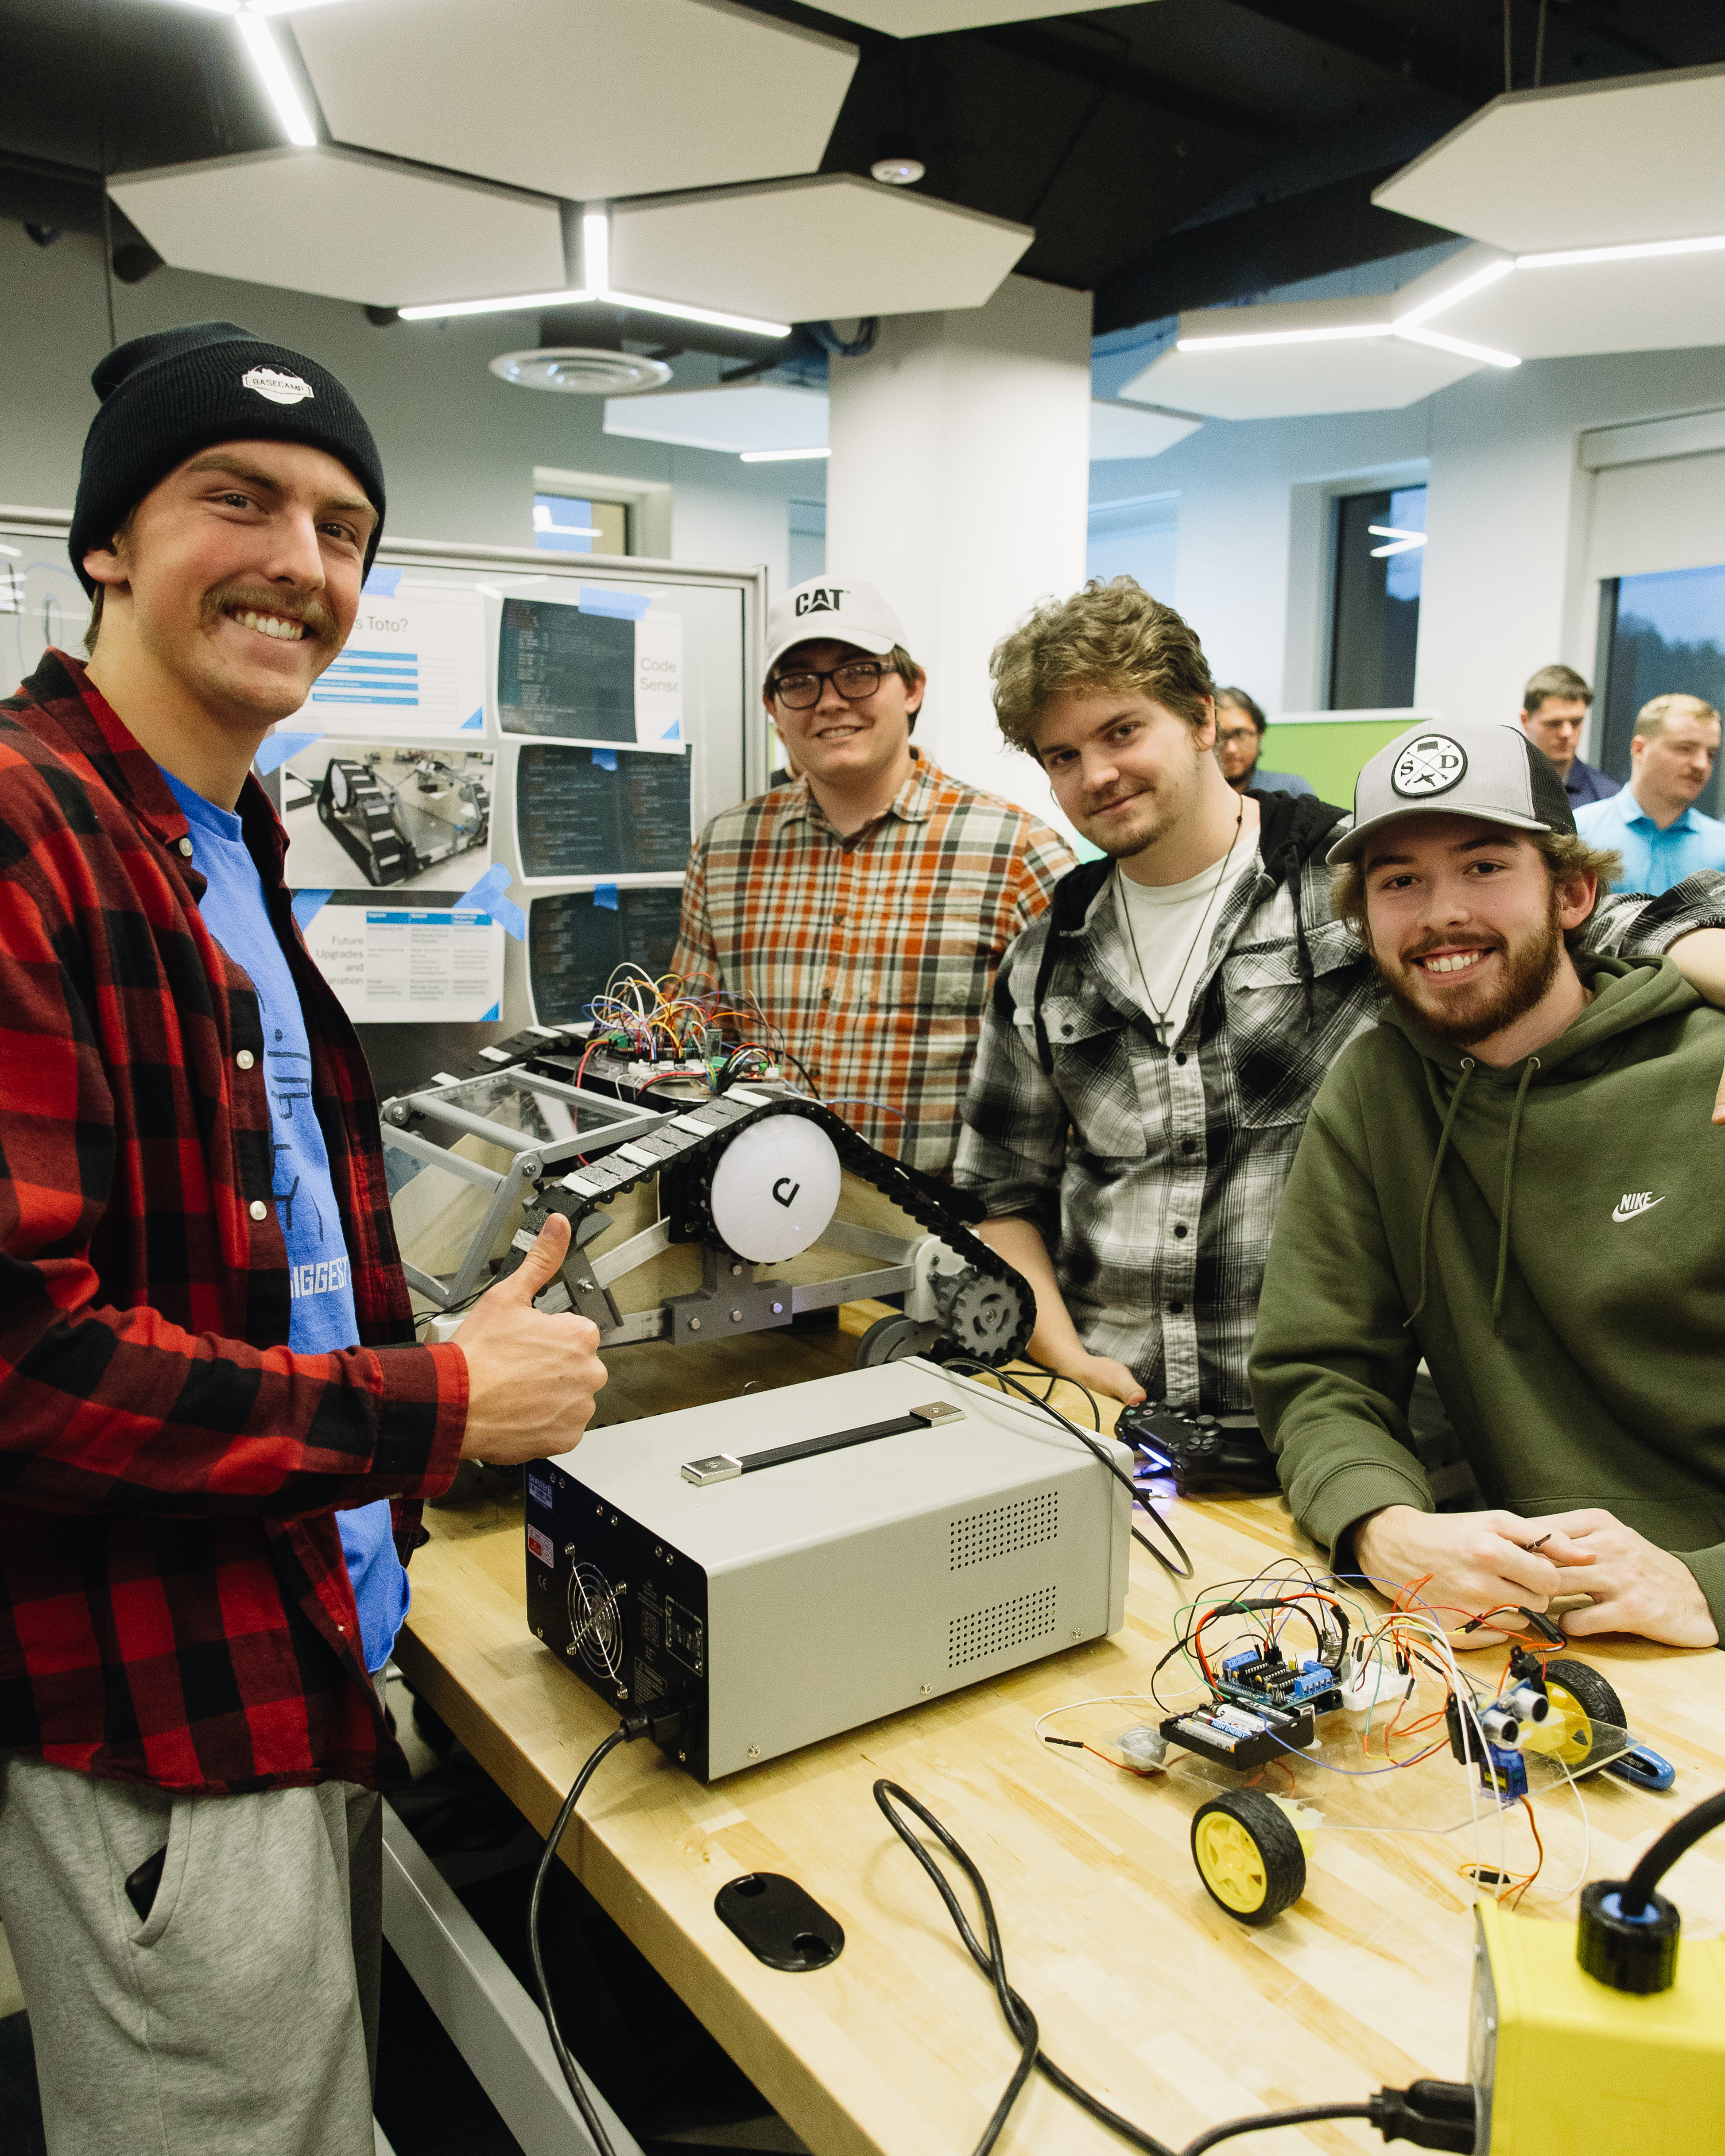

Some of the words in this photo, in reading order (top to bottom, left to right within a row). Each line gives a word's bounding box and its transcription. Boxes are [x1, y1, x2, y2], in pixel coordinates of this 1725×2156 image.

[252, 378, 304, 391] BASECAMP
[795, 589, 844, 616] CAT
[367, 616, 408, 632] Toto?
[640, 657, 676, 673] Code
[345, 963, 364, 972] and
[1620, 1192, 1653, 1211] NIKE
[1211, 1720, 1225, 1730] HIGH
[1224, 1725, 1247, 1739] ENERGY
